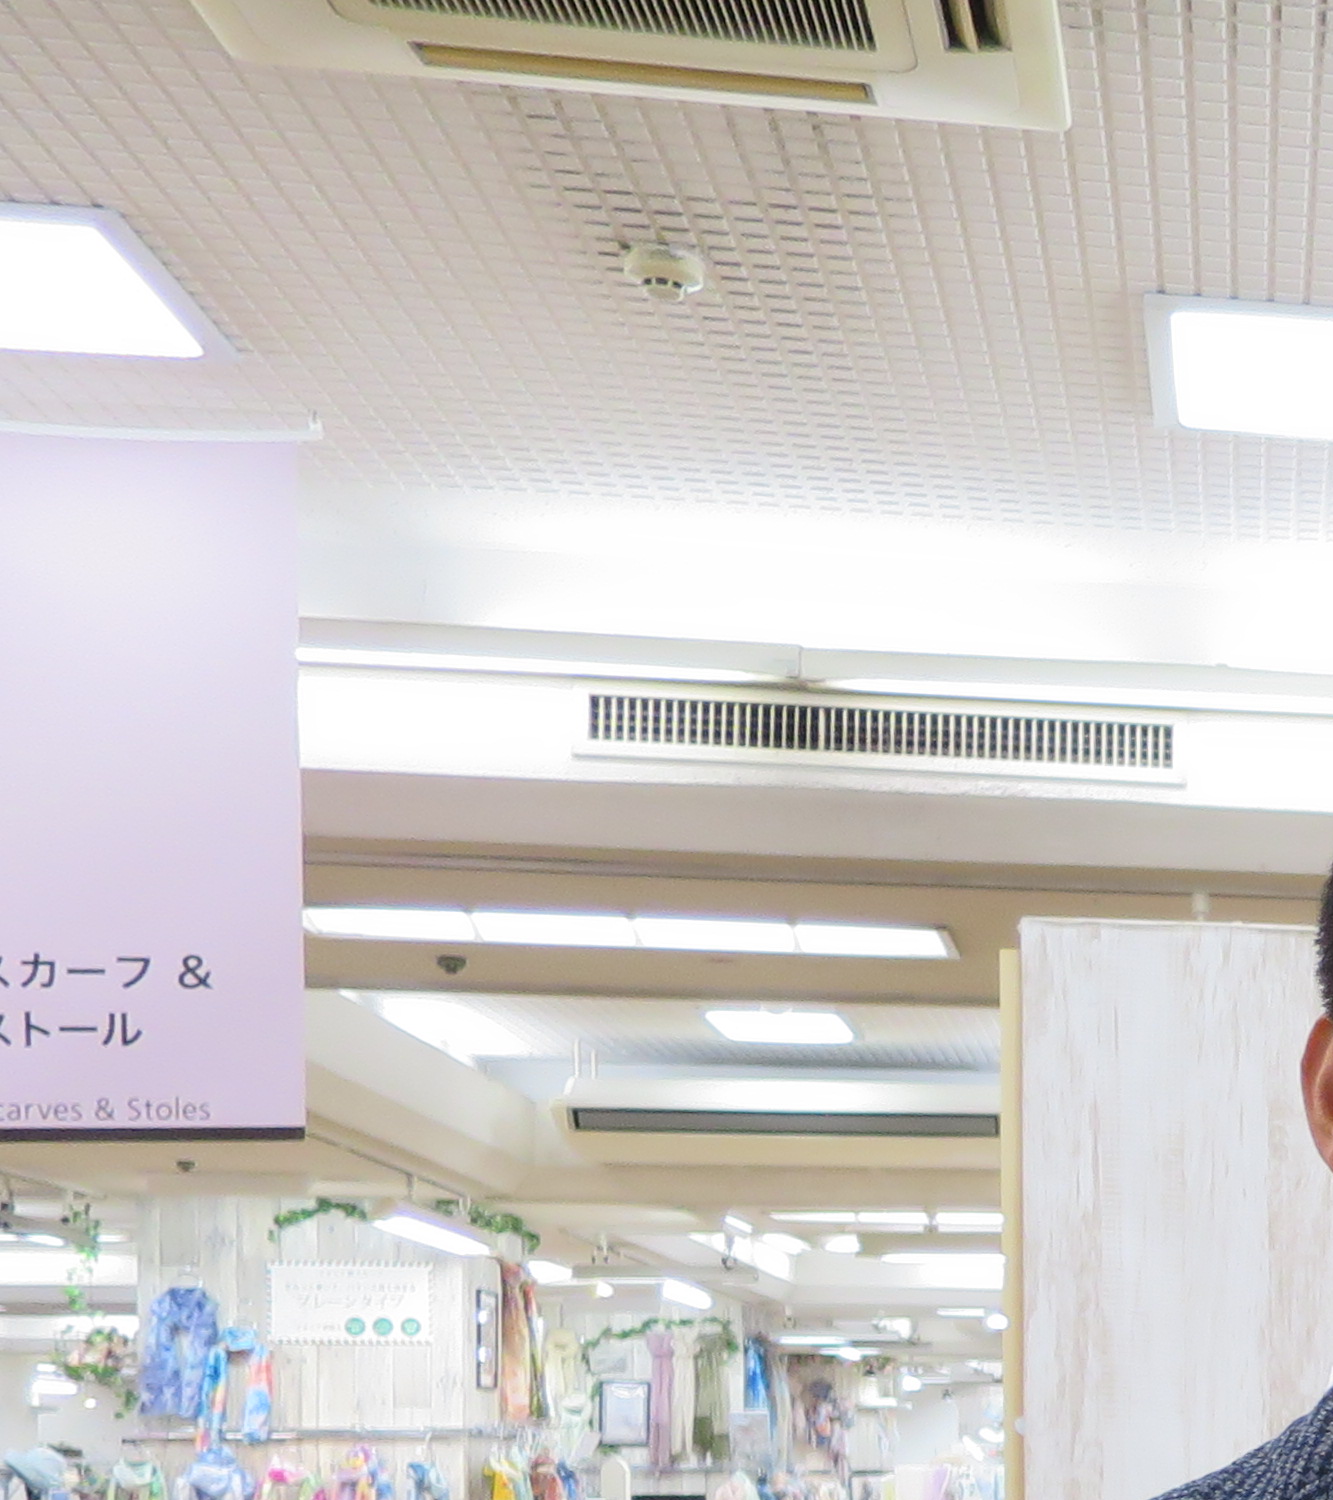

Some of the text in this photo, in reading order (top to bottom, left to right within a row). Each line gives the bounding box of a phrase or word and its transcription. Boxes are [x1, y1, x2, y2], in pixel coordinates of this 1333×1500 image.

[178, 954, 213, 989] &
[94, 1097, 115, 1121] &
[127, 1096, 211, 1122] Stoles
